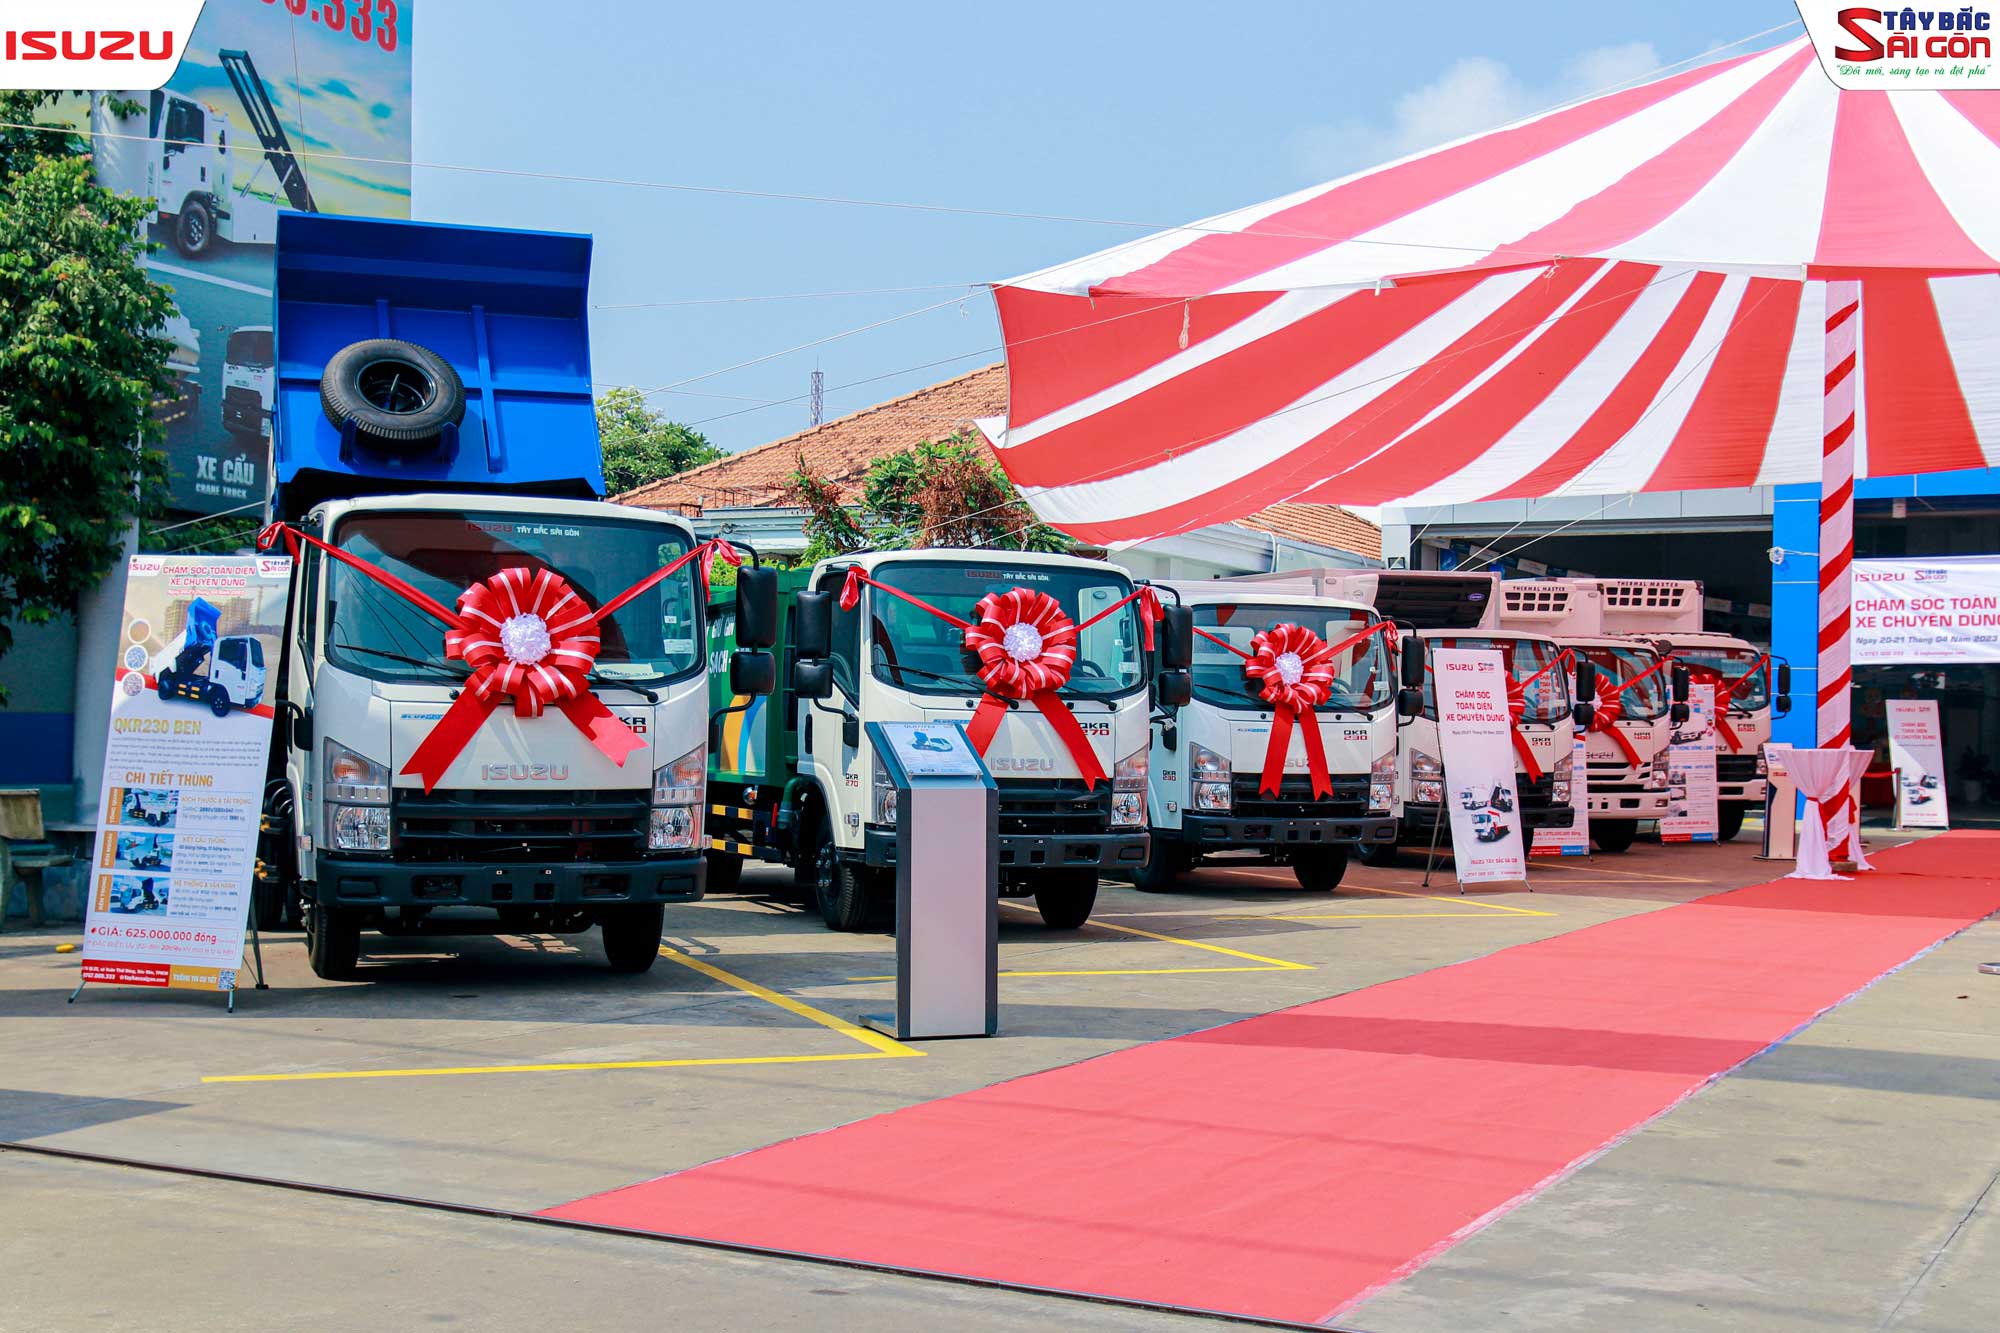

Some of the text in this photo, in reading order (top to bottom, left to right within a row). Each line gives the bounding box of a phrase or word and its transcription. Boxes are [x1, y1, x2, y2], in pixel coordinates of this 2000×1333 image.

[197, 455, 217, 480] XE
[195, 483, 247, 499] CRANE TRUCK
[516, 526, 531, 534] TÂY
[129, 564, 160, 572] ISUZU
[1855, 573, 1905, 582] ISUZU
[1856, 616, 1877, 628] XE
[114, 718, 202, 735] QKR230 BEN
[618, 717, 647, 725] KR
[991, 757, 1054, 771] ISUZU
[126, 771, 145, 783] CHI
[481, 763, 569, 781] ISUZU
[125, 928, 192, 942] 625.000.000
